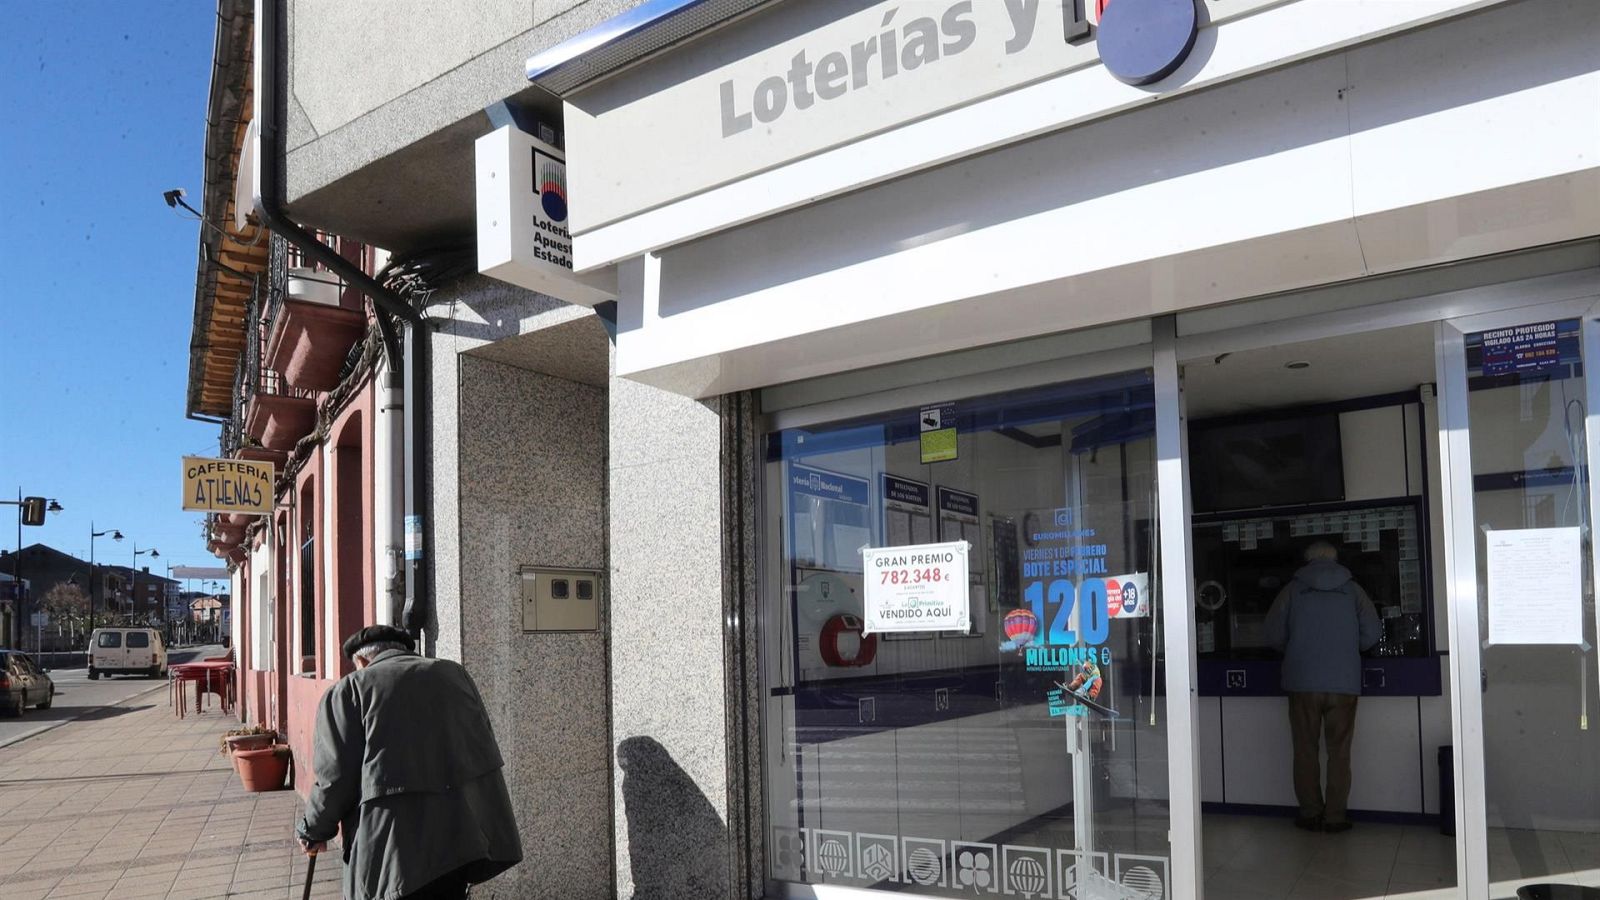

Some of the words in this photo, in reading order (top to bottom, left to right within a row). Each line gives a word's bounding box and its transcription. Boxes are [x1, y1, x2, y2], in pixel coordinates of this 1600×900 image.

[719, 0, 977, 137] Loterías
[1005, 0, 1040, 54] y
[533, 246, 573, 270] Estado
[1483, 329, 1513, 340] RECINTO
[1515, 323, 1555, 335] PROTEGIDO
[1484, 337, 1512, 347] VIGILADO
[1525, 334, 1533, 342] 24
[1535, 330, 1556, 340] HORAS
[188, 462, 270, 483] CAFETERIA
[195, 474, 263, 510] ATHENAS
[1033, 530, 1095, 541] EUROMILLONES
[875, 556, 907, 568] GRAN
[911, 553, 953, 565] PREMIO
[1023, 547, 1053, 561] VIERNES
[1023, 561, 1051, 577] BOTE
[1053, 558, 1108, 576] ESPECIAL
[881, 569, 941, 584] 782.348
[1123, 588, 1136, 600] +18
[879, 608, 922, 619] VENDIDO
[926, 605, 952, 618] AQUÍ
[1023, 577, 1110, 646] 120
[1026, 647, 1098, 667] MILLONES
